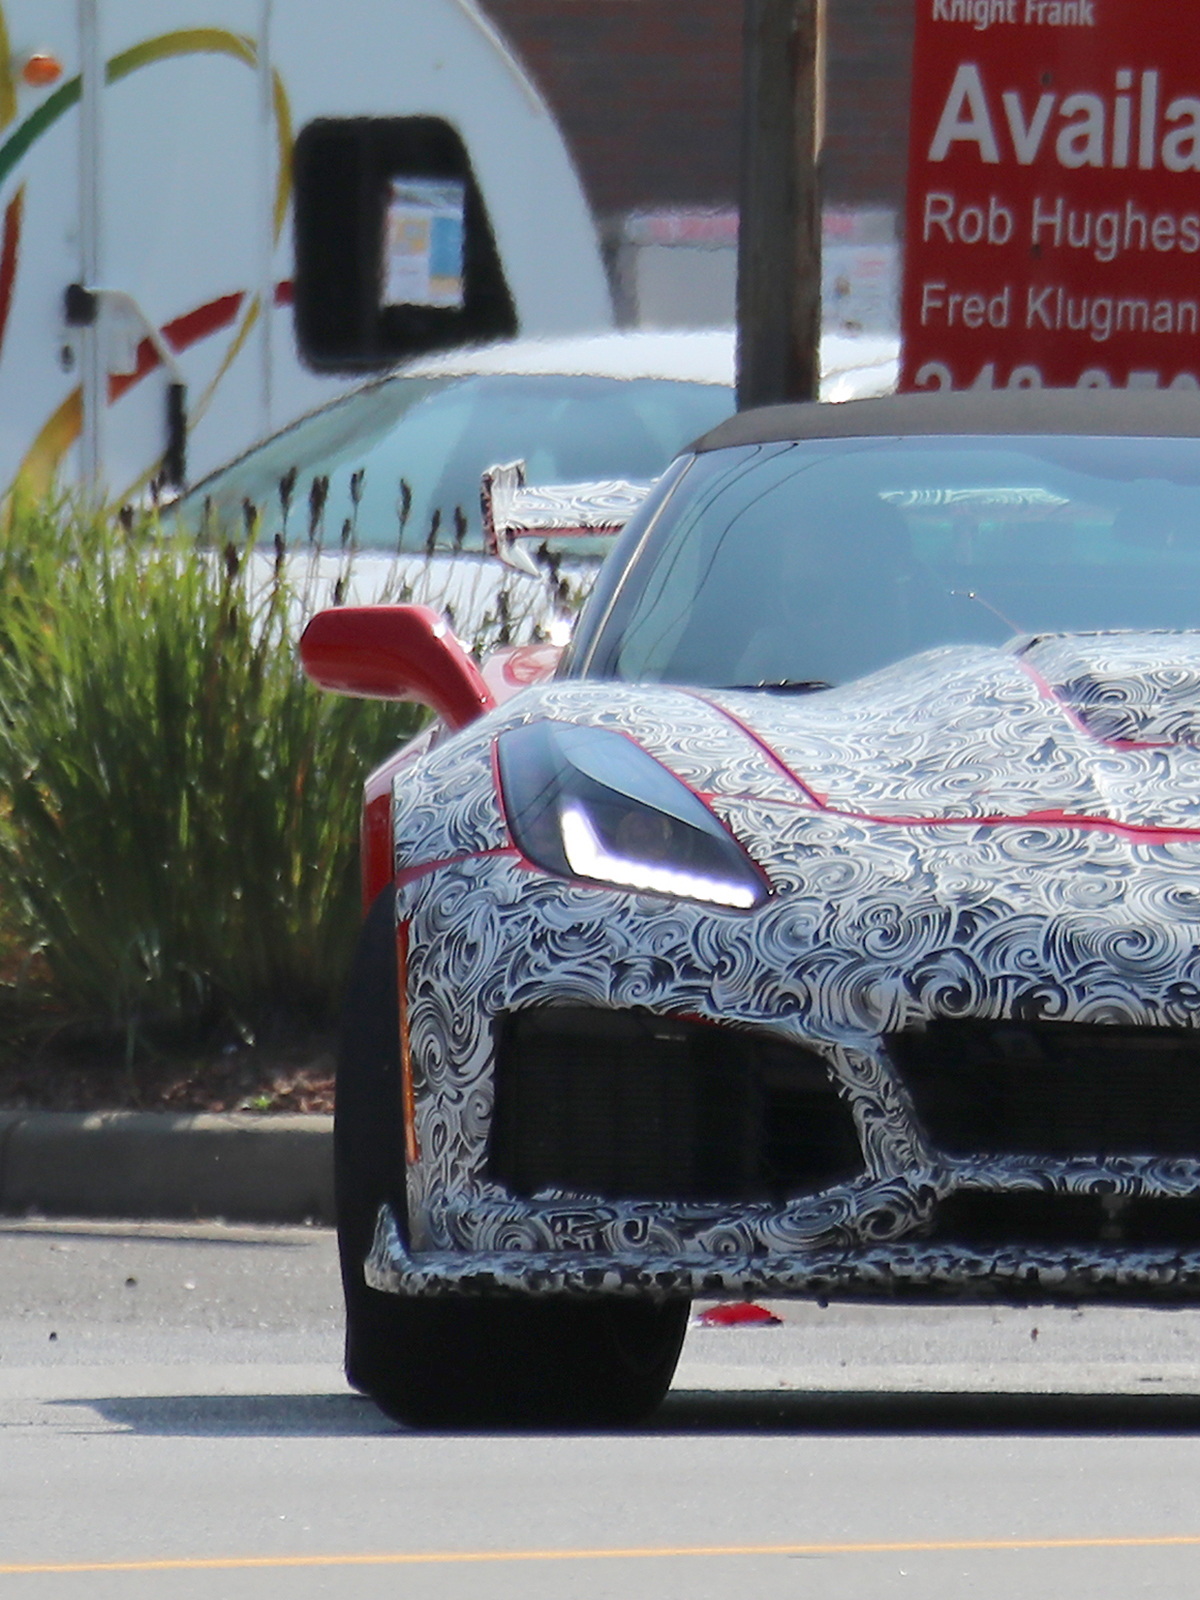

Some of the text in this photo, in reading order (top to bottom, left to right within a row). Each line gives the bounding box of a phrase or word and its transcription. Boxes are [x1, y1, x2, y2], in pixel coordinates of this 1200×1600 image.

[932, 0, 1095, 31] Knight Frank
[923, 192, 1014, 245] Rob
[920, 283, 1198, 342] Fred Klugman
